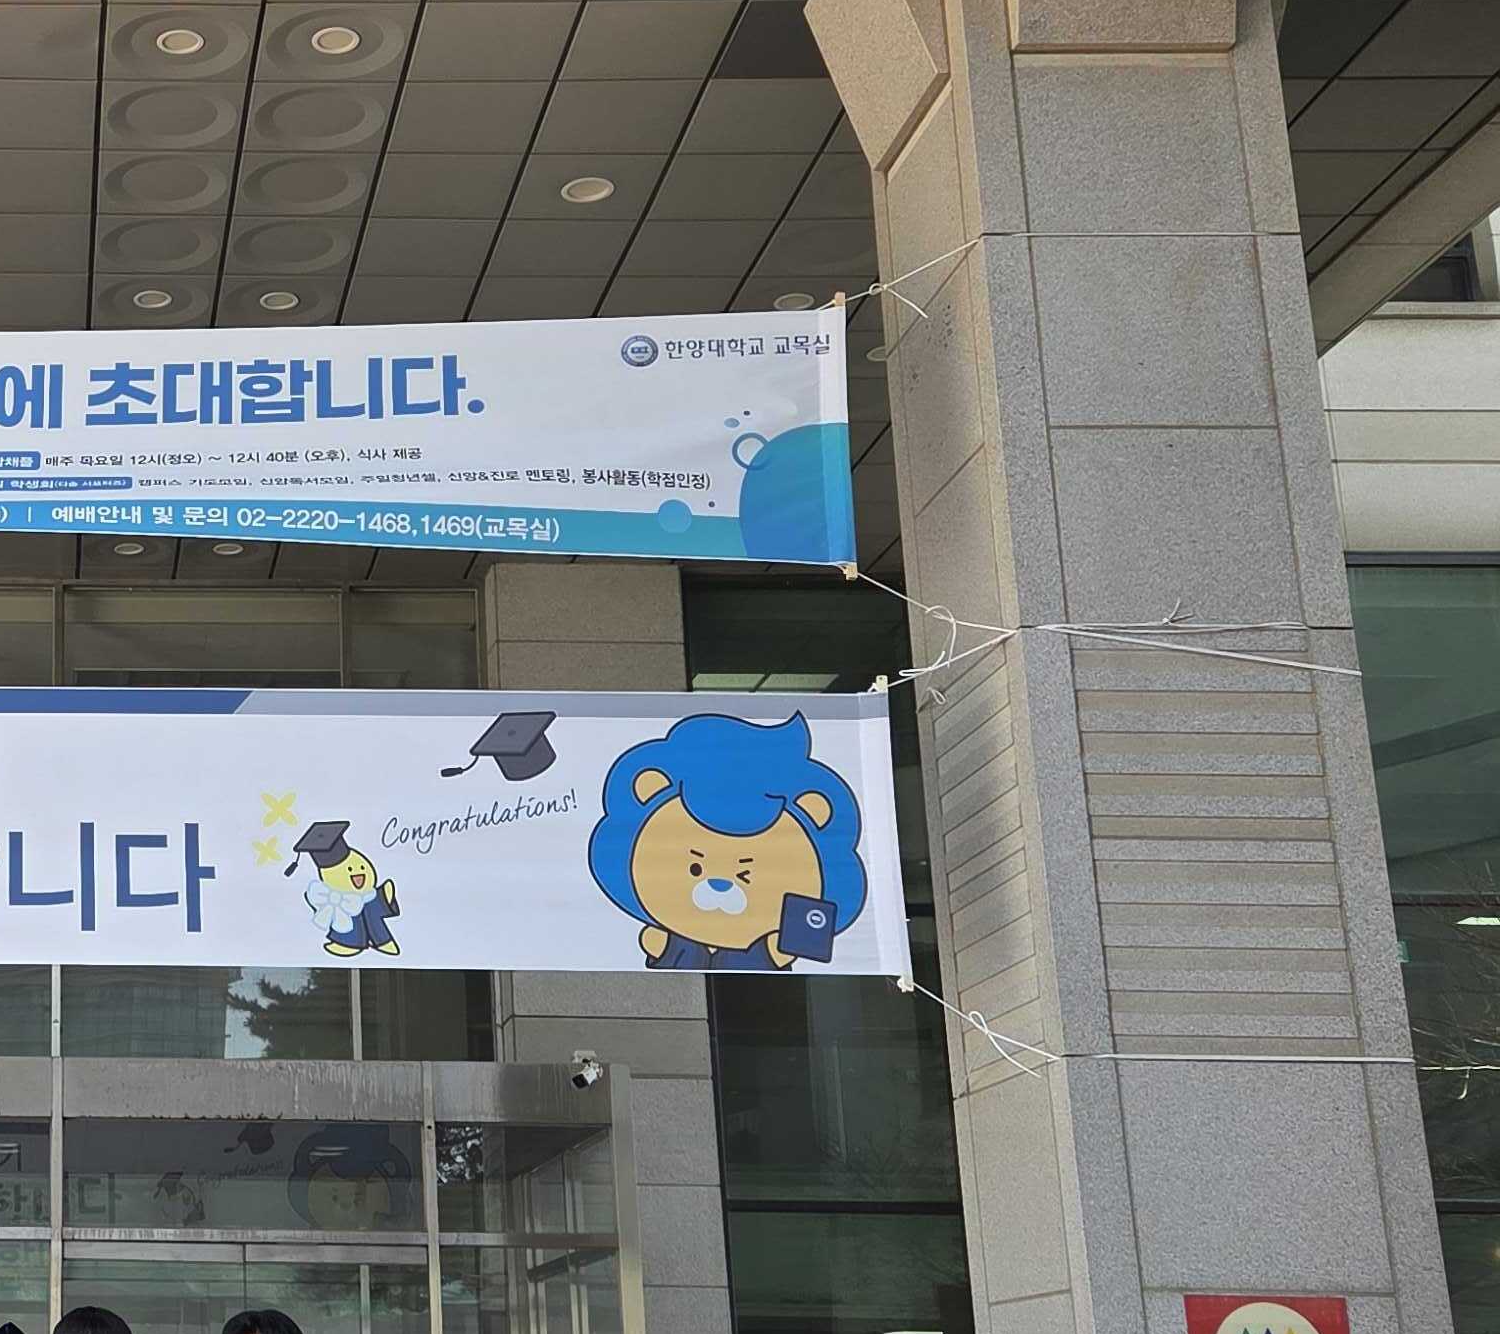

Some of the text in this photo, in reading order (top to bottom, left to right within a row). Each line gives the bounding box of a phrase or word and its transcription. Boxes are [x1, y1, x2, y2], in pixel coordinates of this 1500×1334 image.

[665, 337, 765, 360] 한양대학교
[775, 334, 831, 356] 교목실
[85, 354, 486, 427] 초대합니다.
[45, 454, 75, 467] 매주
[80, 454, 123, 466] 목요일
[130, 452, 202, 465] 12시(정오)
[229, 451, 260, 463] 12시
[266, 450, 300, 463] 40분
[357, 447, 387, 461] 식사
[392, 447, 422, 460] 제공
[525, 467, 577, 485] 멘토링,
[581, 468, 712, 491] 봉사활동(학점인정)
[51, 504, 143, 525] 예배안내
[152, 505, 174, 525] 및
[183, 505, 228, 526] 문의
[236, 507, 561, 543] 02-2220-1468,1469(교목실)
[381, 788, 578, 855] Congratulations!
